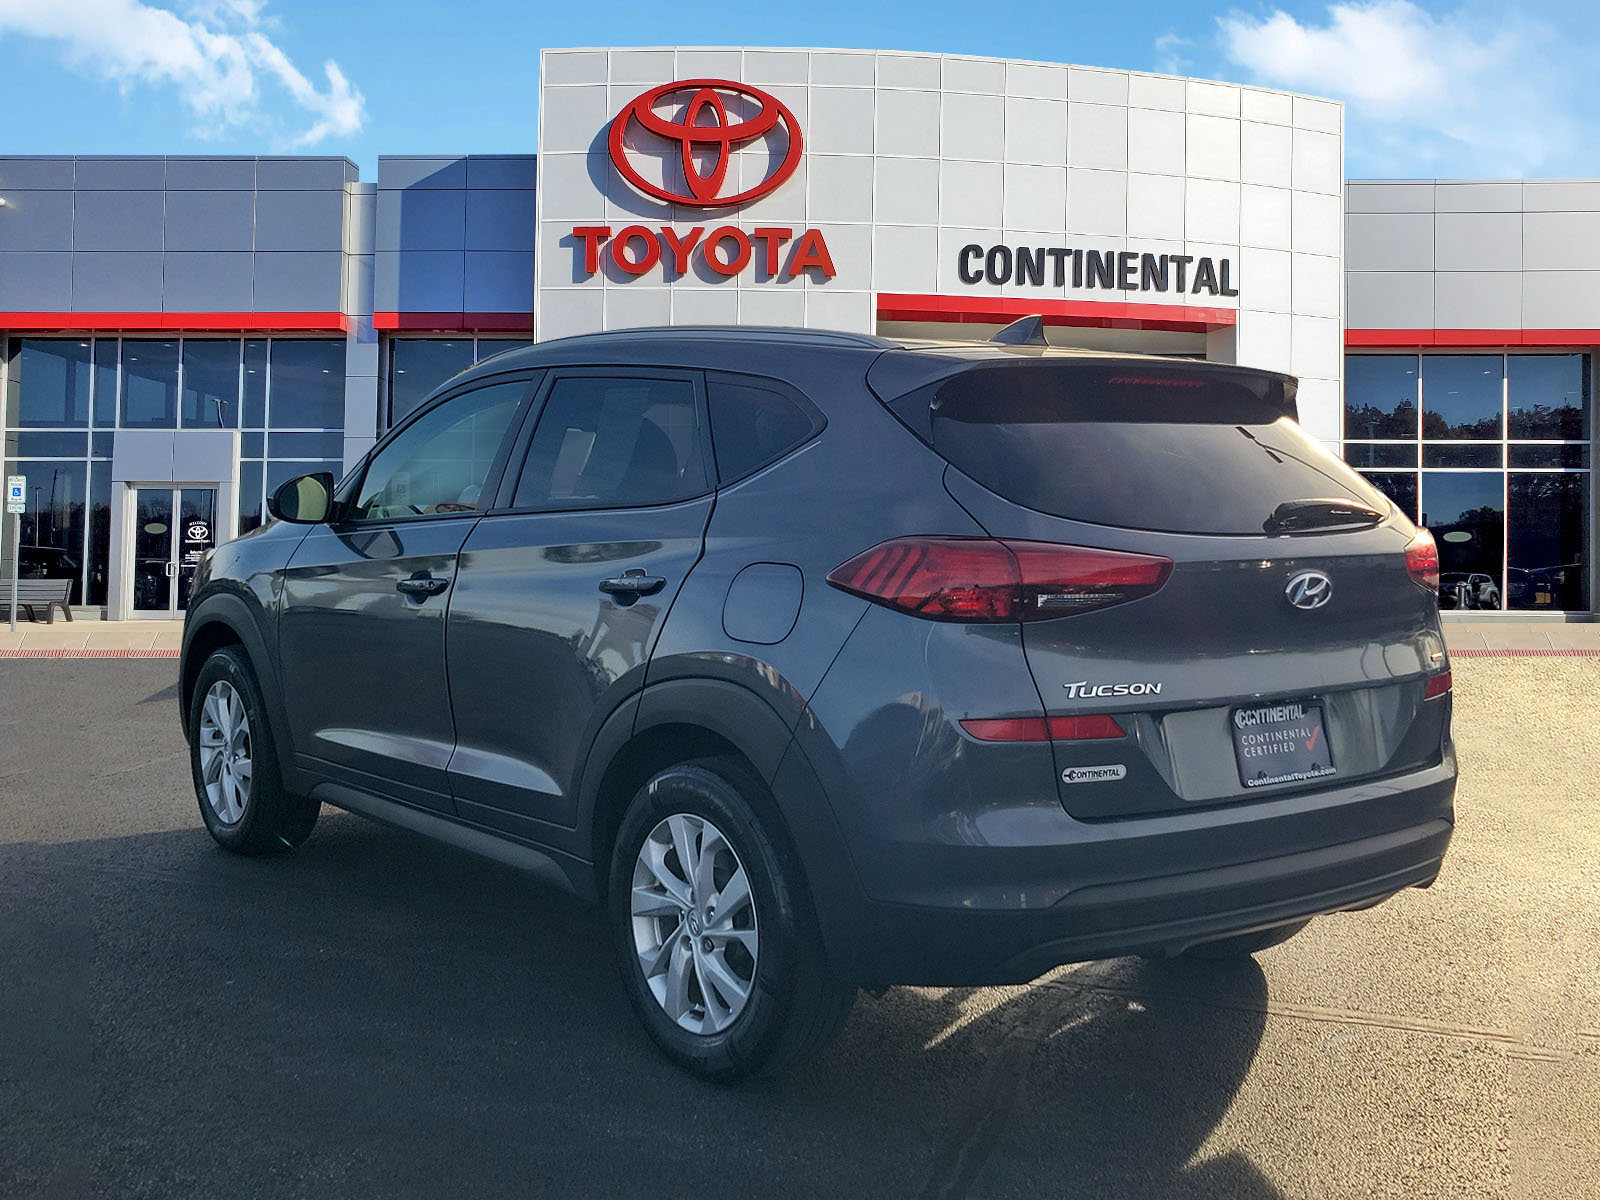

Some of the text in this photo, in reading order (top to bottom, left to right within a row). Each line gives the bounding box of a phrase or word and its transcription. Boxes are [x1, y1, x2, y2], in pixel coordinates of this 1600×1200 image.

[573, 225, 836, 277] TOYOTA
[958, 244, 1239, 297] CONTINENTAL
[1064, 681, 1162, 699] TUCSON
[1235, 705, 1305, 729] CONTINENTAL
[1242, 728, 1311, 745] CONTINENTAL
[1244, 742, 1295, 758] CERTIFIED
[1069, 769, 1120, 781] CONTINENTAL
[1247, 767, 1337, 787] ContinentalToyota.com
